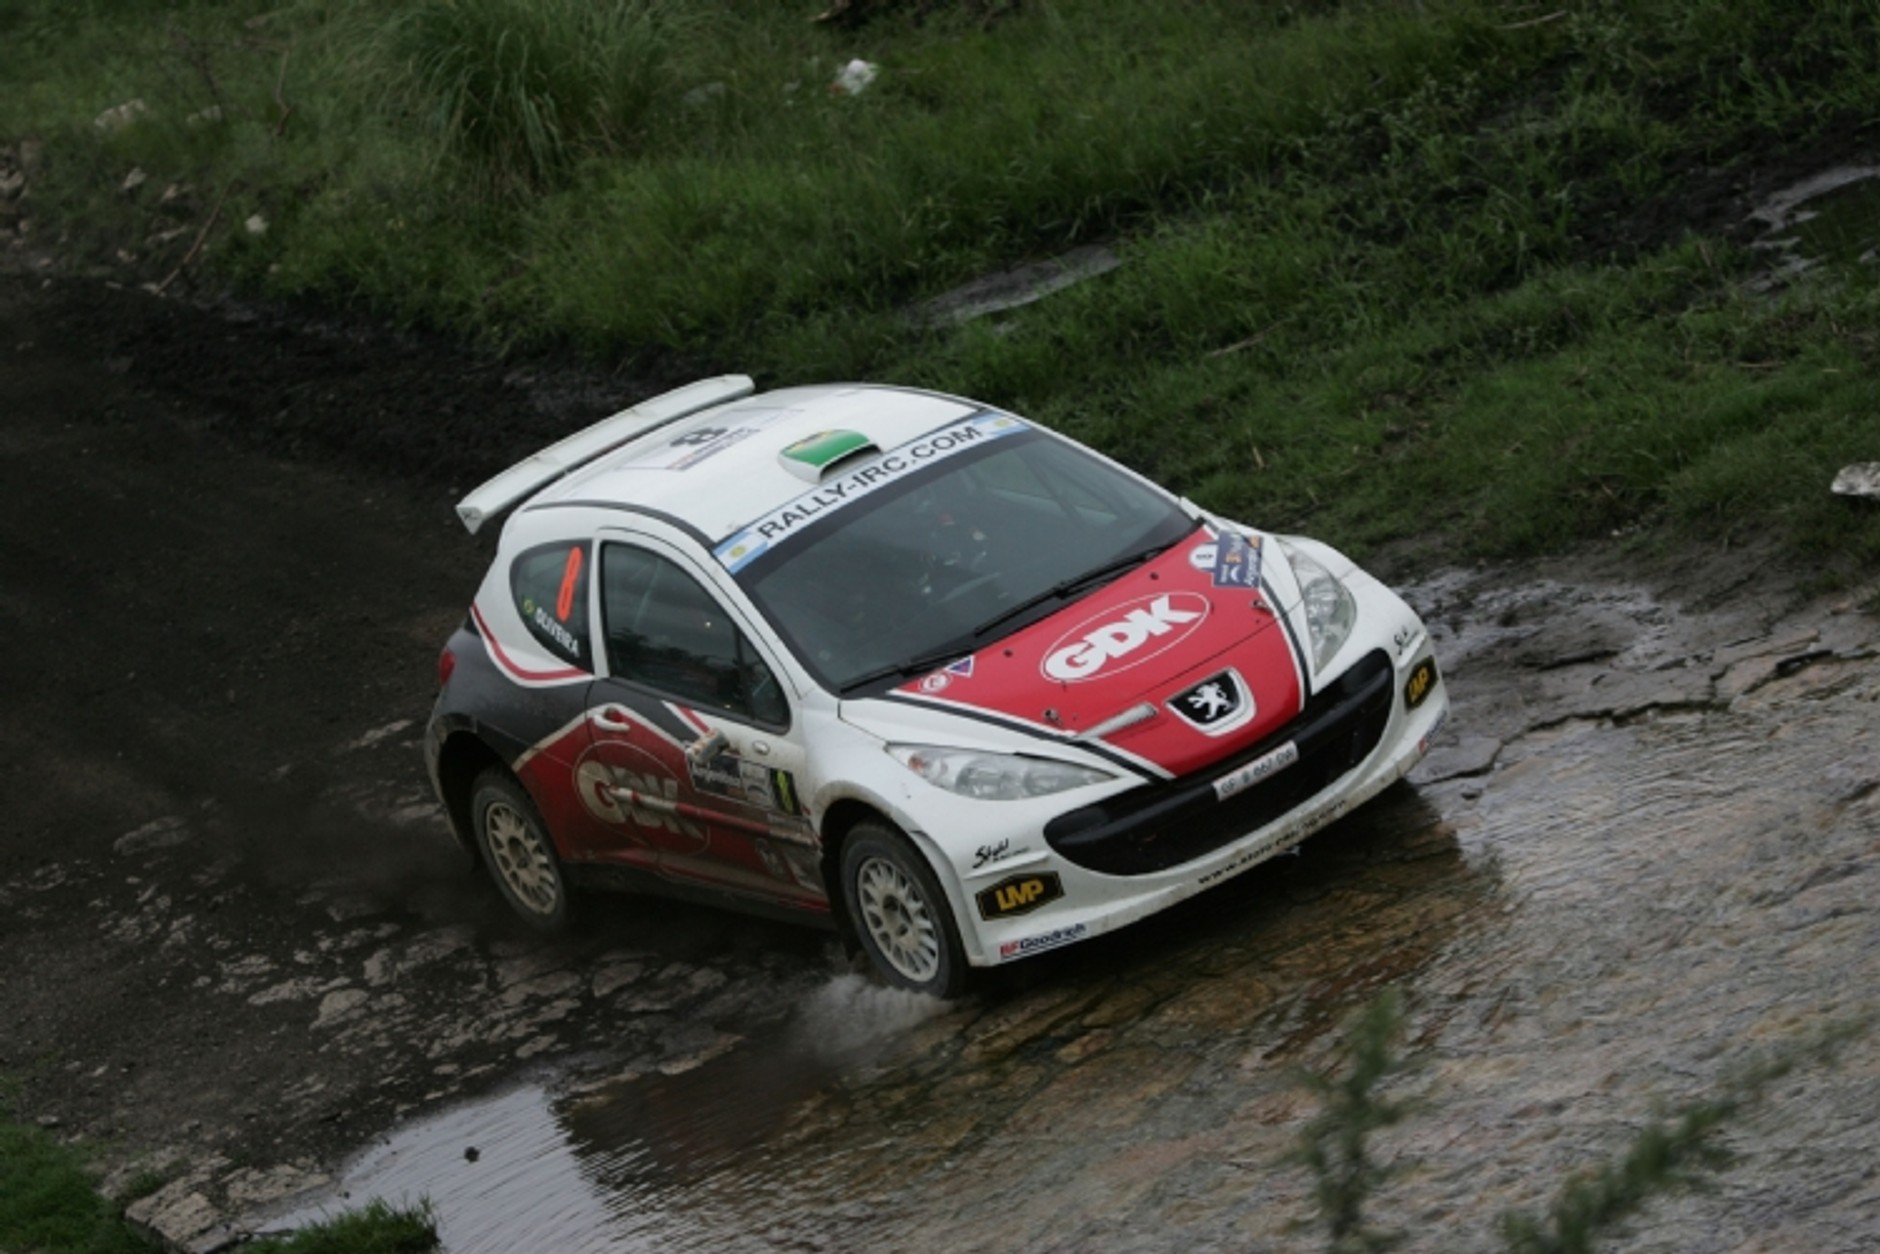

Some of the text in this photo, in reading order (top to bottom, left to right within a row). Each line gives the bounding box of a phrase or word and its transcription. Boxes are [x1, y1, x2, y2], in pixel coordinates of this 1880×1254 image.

[758, 425, 984, 540] RALLY-IRC.COM
[556, 546, 583, 623] 8
[1045, 595, 1201, 679] GDK
[995, 879, 1044, 911] LMP
